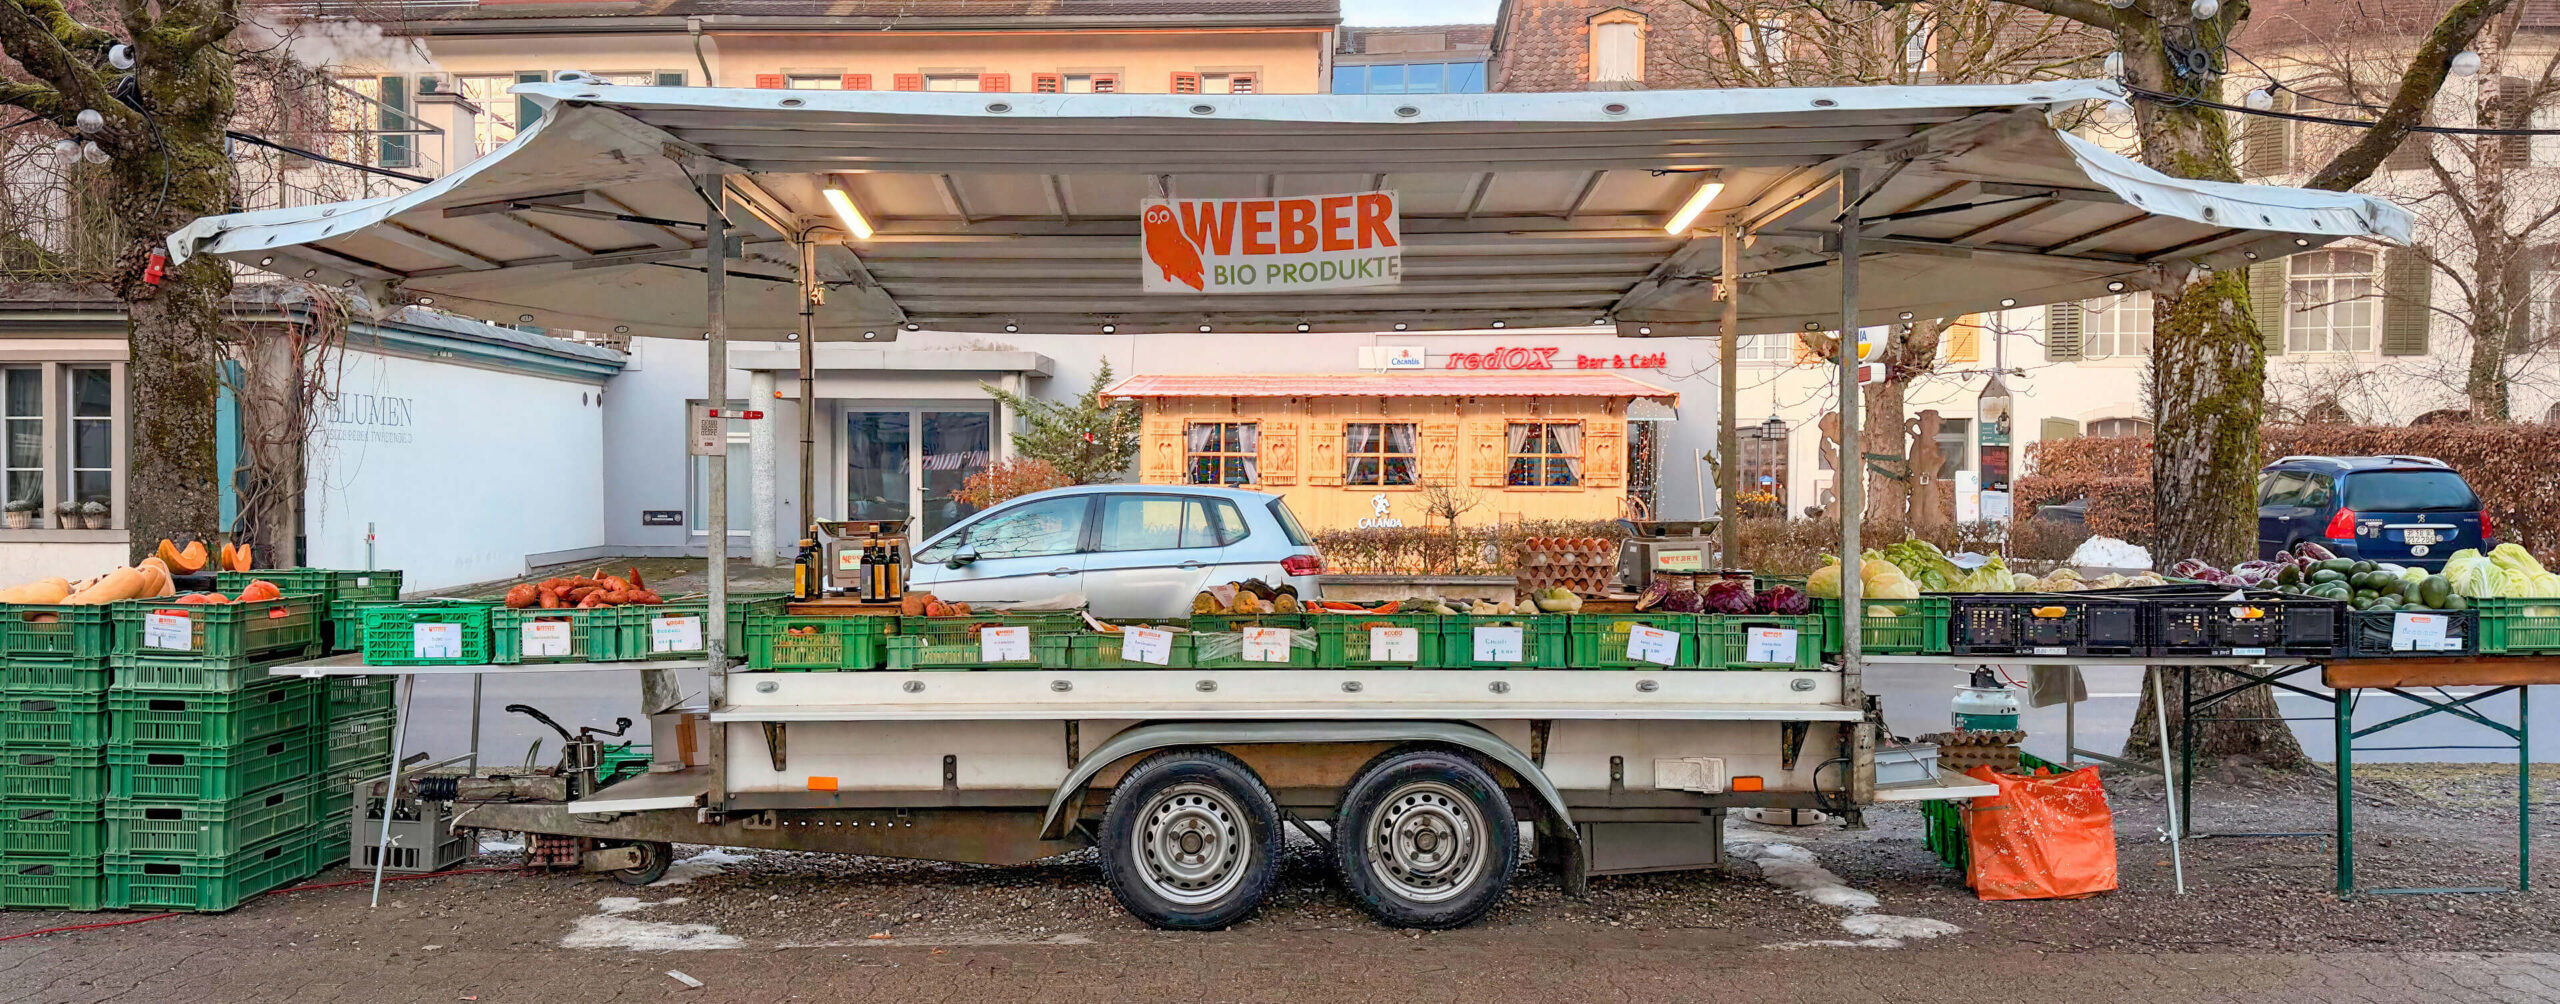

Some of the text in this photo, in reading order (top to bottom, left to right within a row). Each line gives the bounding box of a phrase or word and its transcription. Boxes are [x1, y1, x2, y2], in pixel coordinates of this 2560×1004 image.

[1179, 193, 1398, 256] WEBER
[1214, 255, 1399, 286] BIO PRODUKTE
[1445, 347, 1559, 370] redOX
[1612, 353, 1626, 369] &
[327, 391, 413, 427] BLUMEN
[1358, 517, 1403, 529] CALANDA
